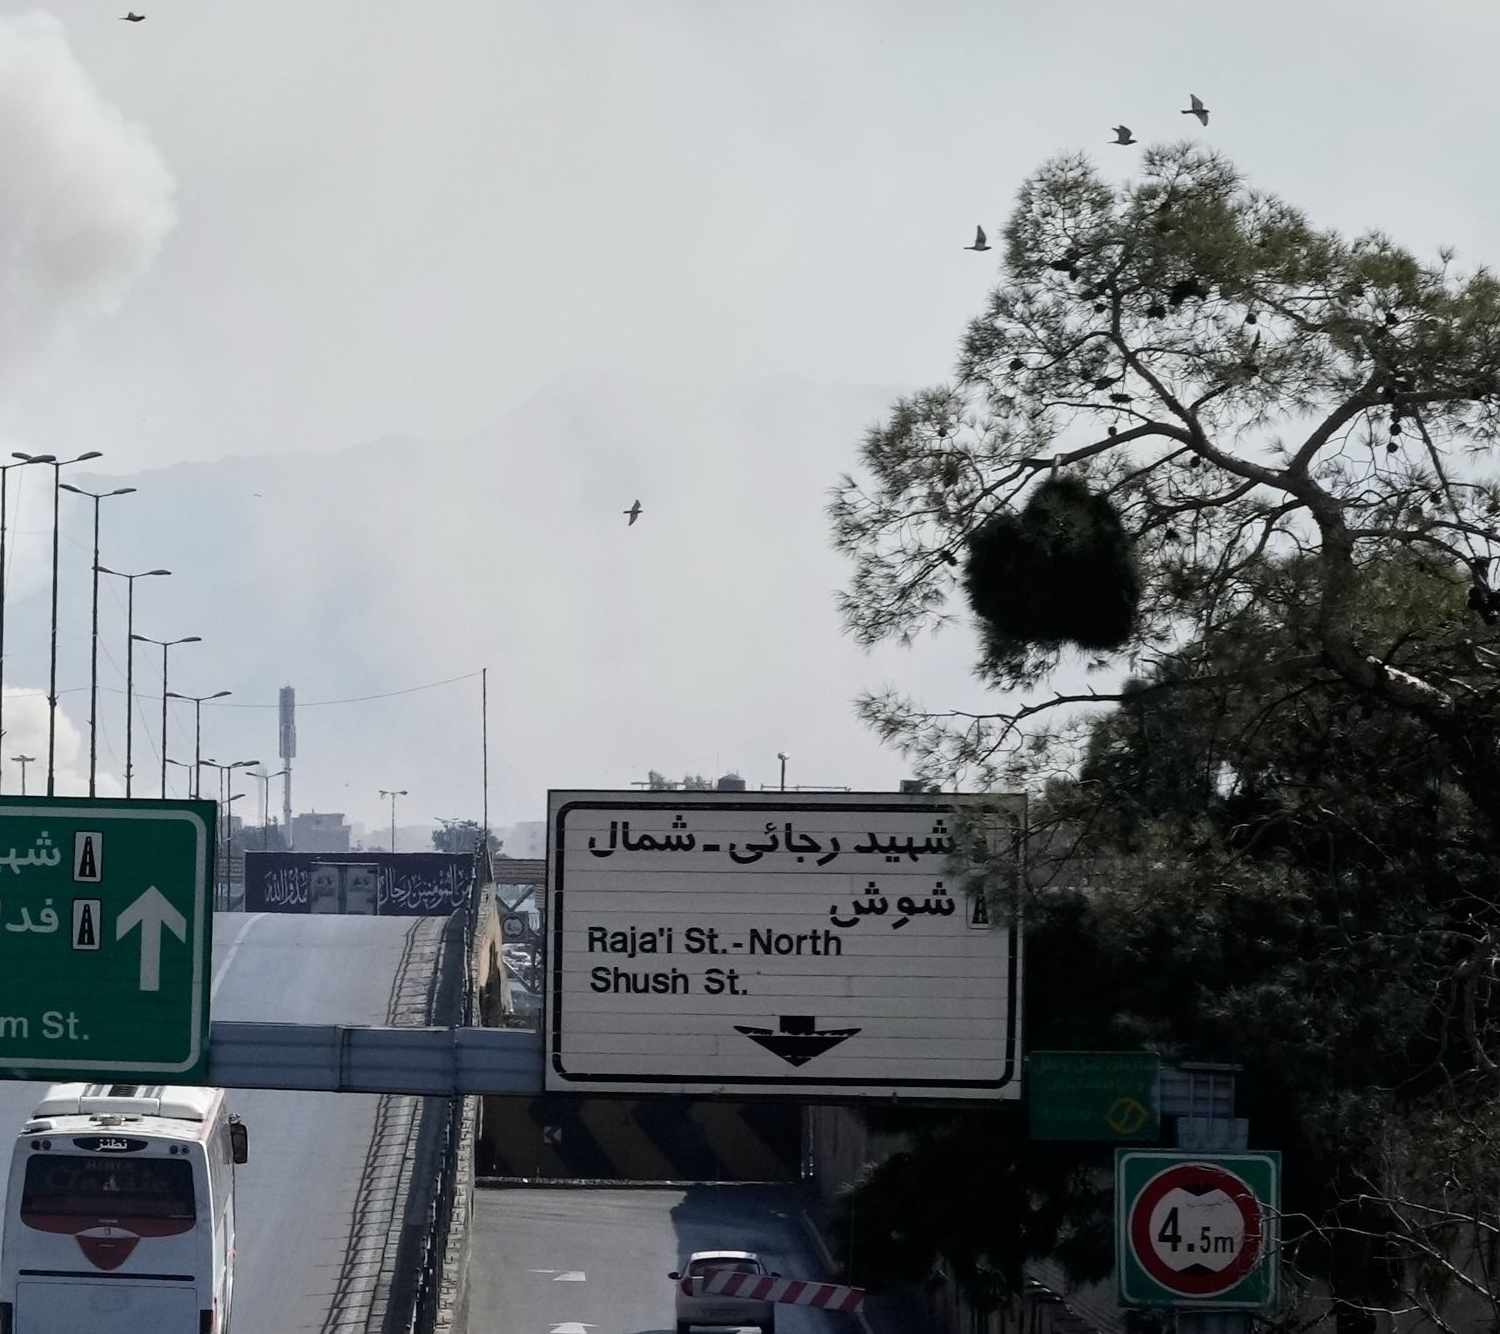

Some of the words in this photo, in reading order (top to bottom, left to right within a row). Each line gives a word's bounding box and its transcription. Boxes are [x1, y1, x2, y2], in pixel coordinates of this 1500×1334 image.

[589, 815, 695, 857] شمال
[854, 820, 955, 862] شهید
[830, 882, 955, 930] شوش
[588, 926, 672, 958] Raja'i
[685, 928, 727, 954] St.
[750, 929, 841, 955] North
[591, 967, 688, 994] Shush
[704, 969, 747, 995] St.
[42, 1011, 88, 1039] St.
